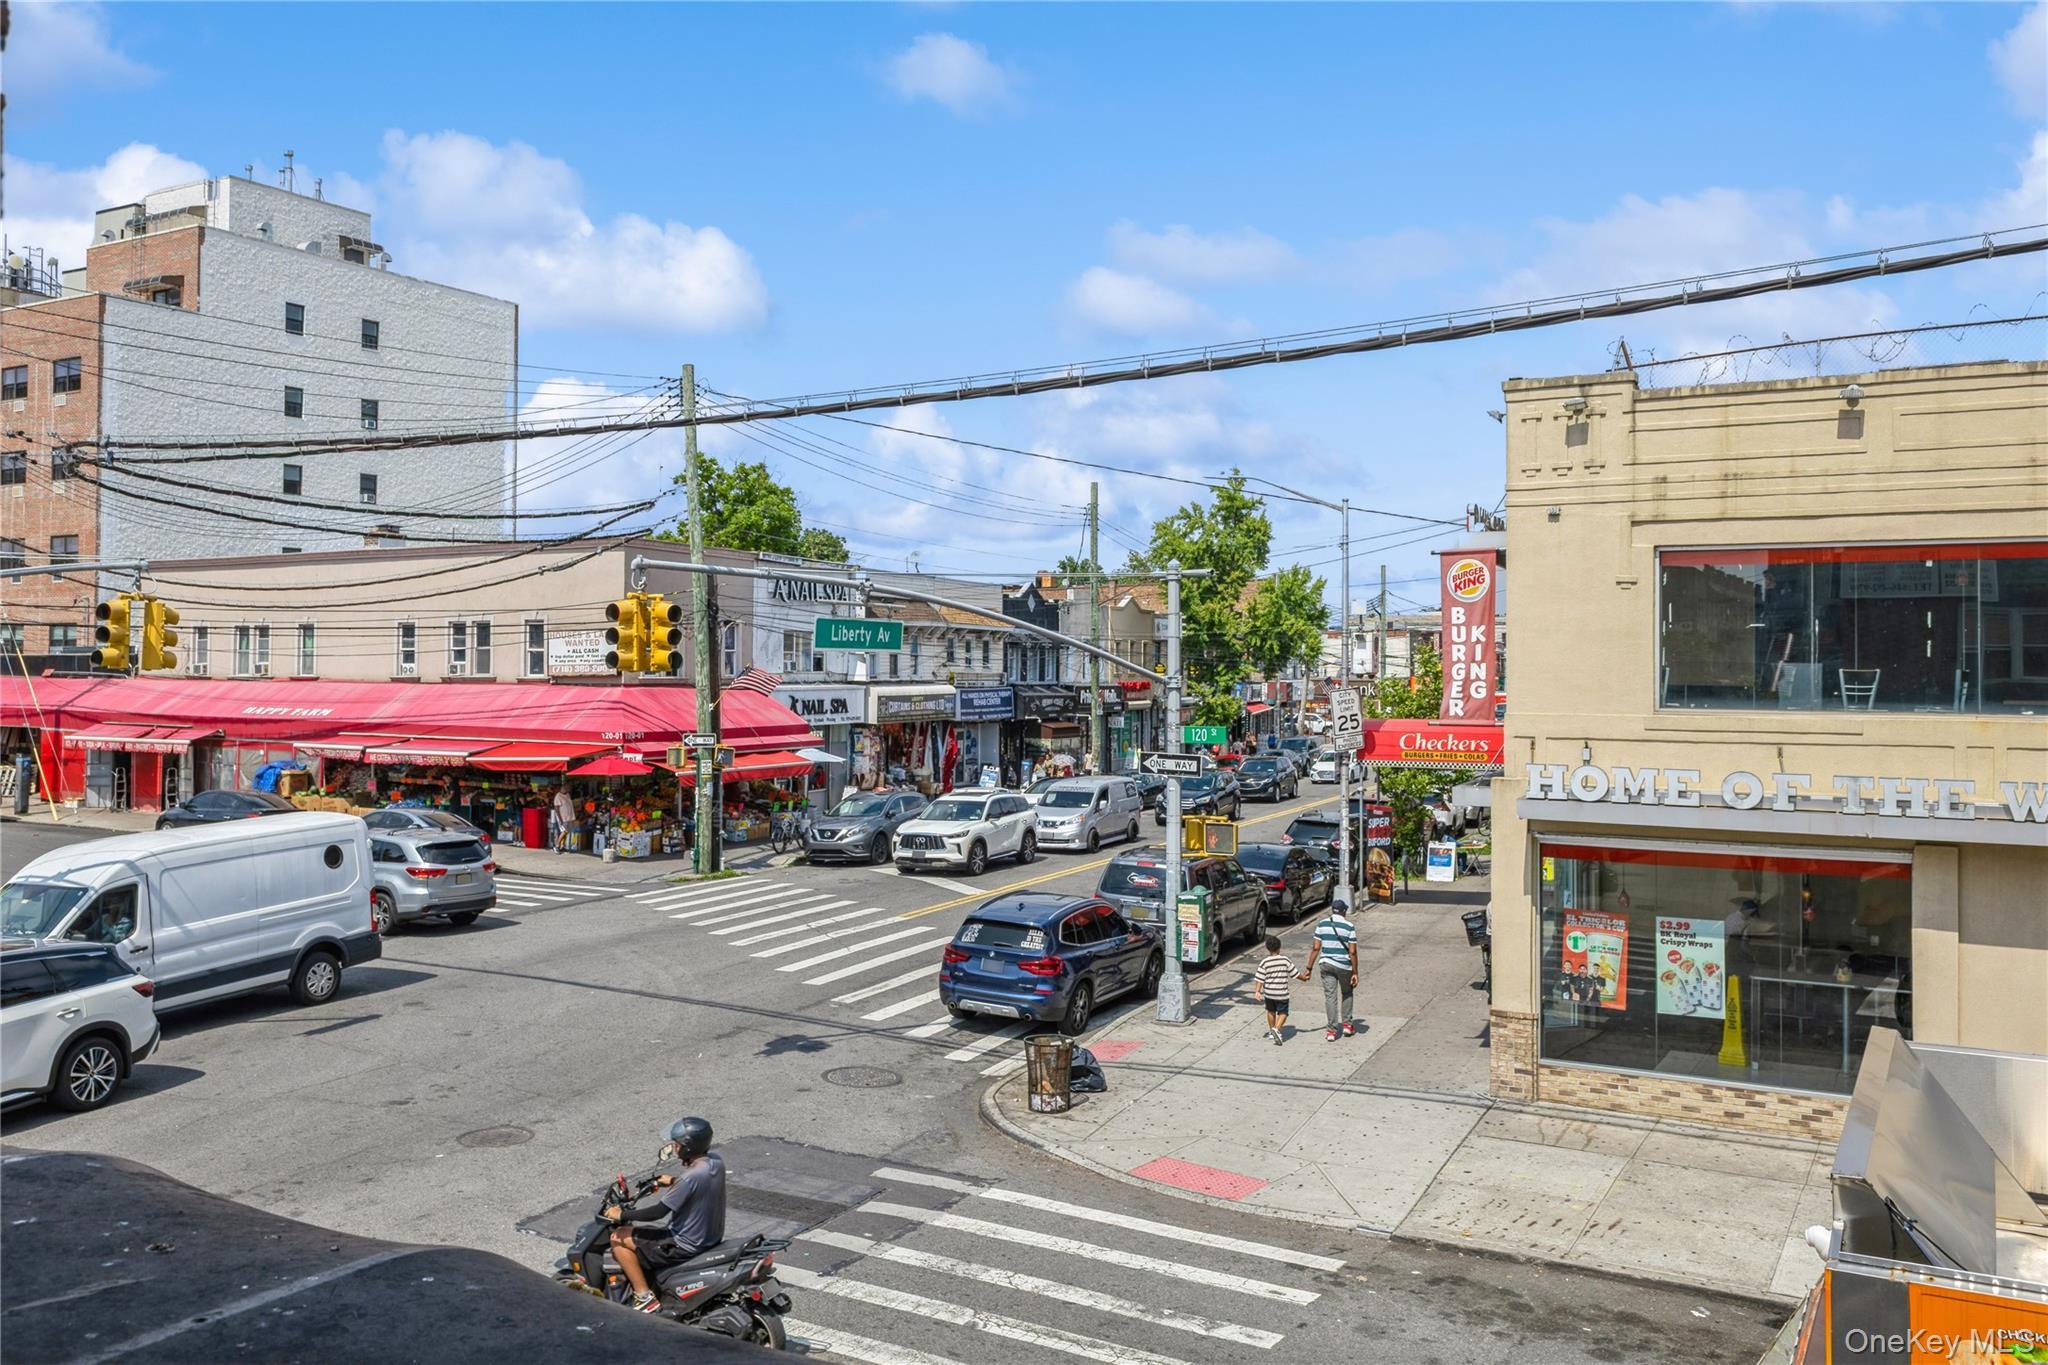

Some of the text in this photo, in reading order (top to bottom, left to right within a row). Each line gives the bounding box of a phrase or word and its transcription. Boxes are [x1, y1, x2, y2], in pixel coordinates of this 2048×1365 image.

[1452, 566, 1485, 583] BURGER
[823, 582, 850, 602] SPA
[1454, 574, 1486, 593] KING
[564, 639, 600, 647] WANTED
[831, 624, 891, 646] Liberty Av
[1449, 606, 1467, 718] BURGER
[1469, 625, 1488, 699] KING
[801, 699, 827, 715] NAIL
[830, 697, 849, 714] SPA
[1337, 698, 1355, 706] SPEED
[1337, 713, 1360, 732] 25
[1191, 728, 1207, 742] 120
[1399, 733, 1489, 752] Checkers
[1149, 759, 1194, 770] ONE WAY
[1525, 763, 1701, 807] HOME
[1721, 771, 1811, 812] OF
[1833, 774, 1976, 820] THE
[1368, 817, 1390, 828] SUPER
[1660, 920, 1690, 930] $2.99
[1660, 938, 1713, 949] Crispy Wraps
[1674, 931, 1697, 940] Royal
